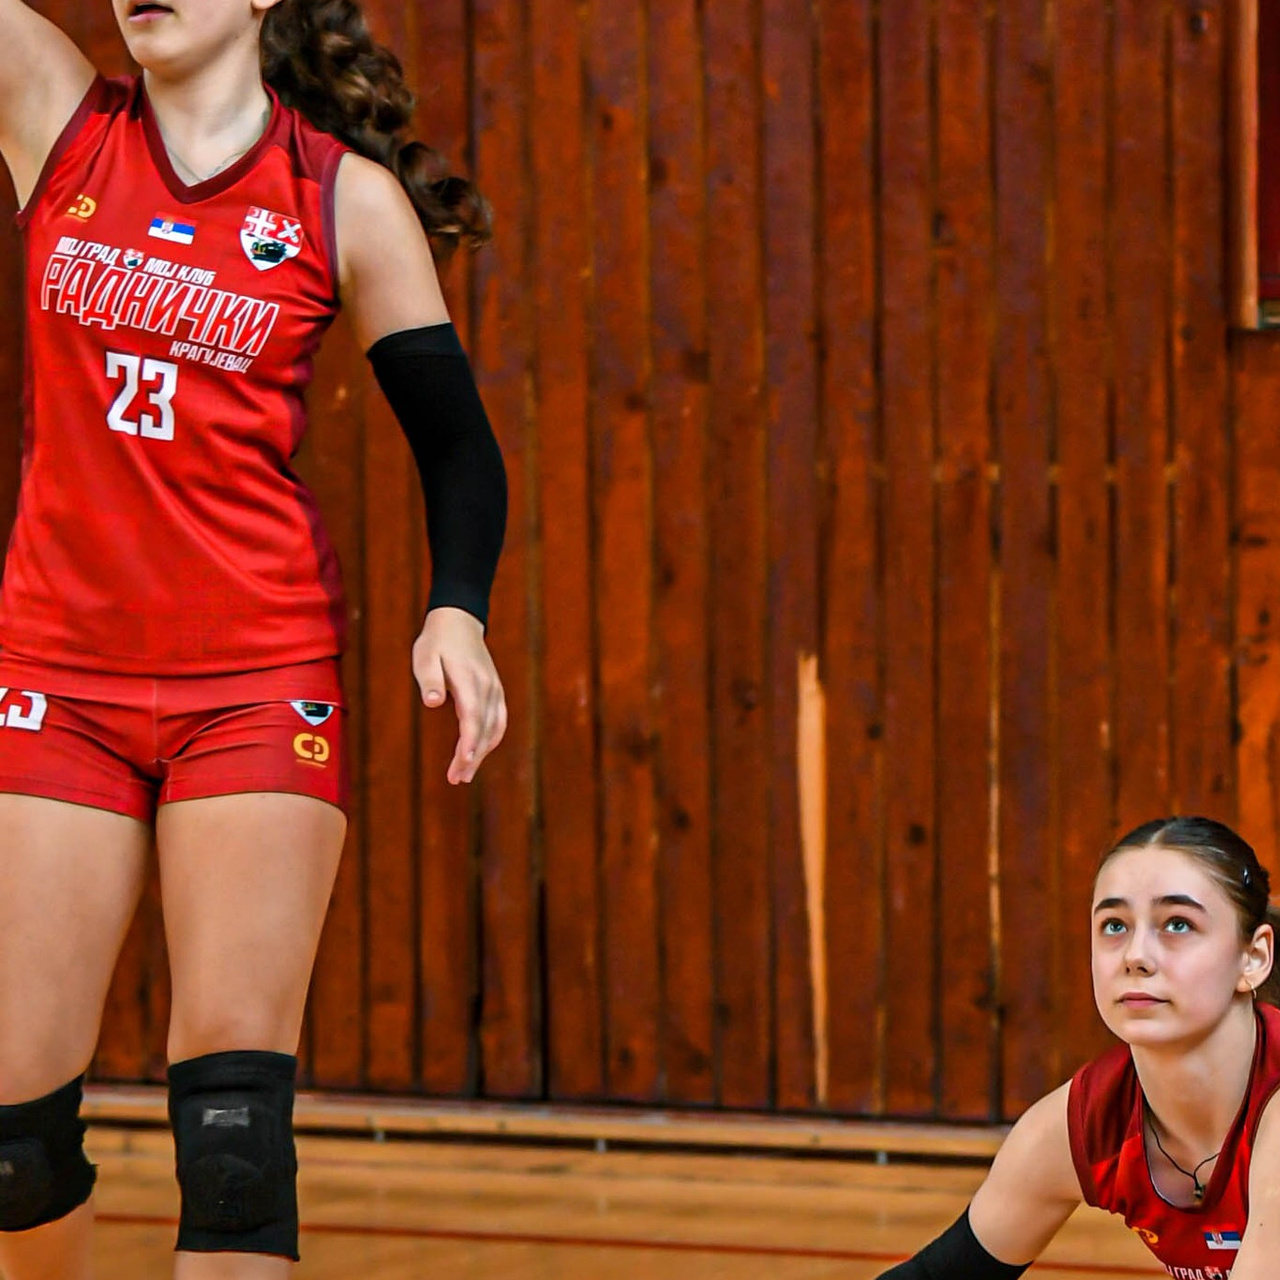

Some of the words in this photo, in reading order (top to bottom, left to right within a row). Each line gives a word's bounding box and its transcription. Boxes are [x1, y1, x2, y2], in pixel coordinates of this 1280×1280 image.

[80, 241, 122, 266] ГРАД
[143, 257, 178, 277] МОЈ
[177, 265, 217, 286] КЛУБ
[41, 253, 280, 357] РАДНИЧКИ
[169, 341, 254, 374] КРАГУЈЕВАЦ
[105, 351, 178, 441] 23
